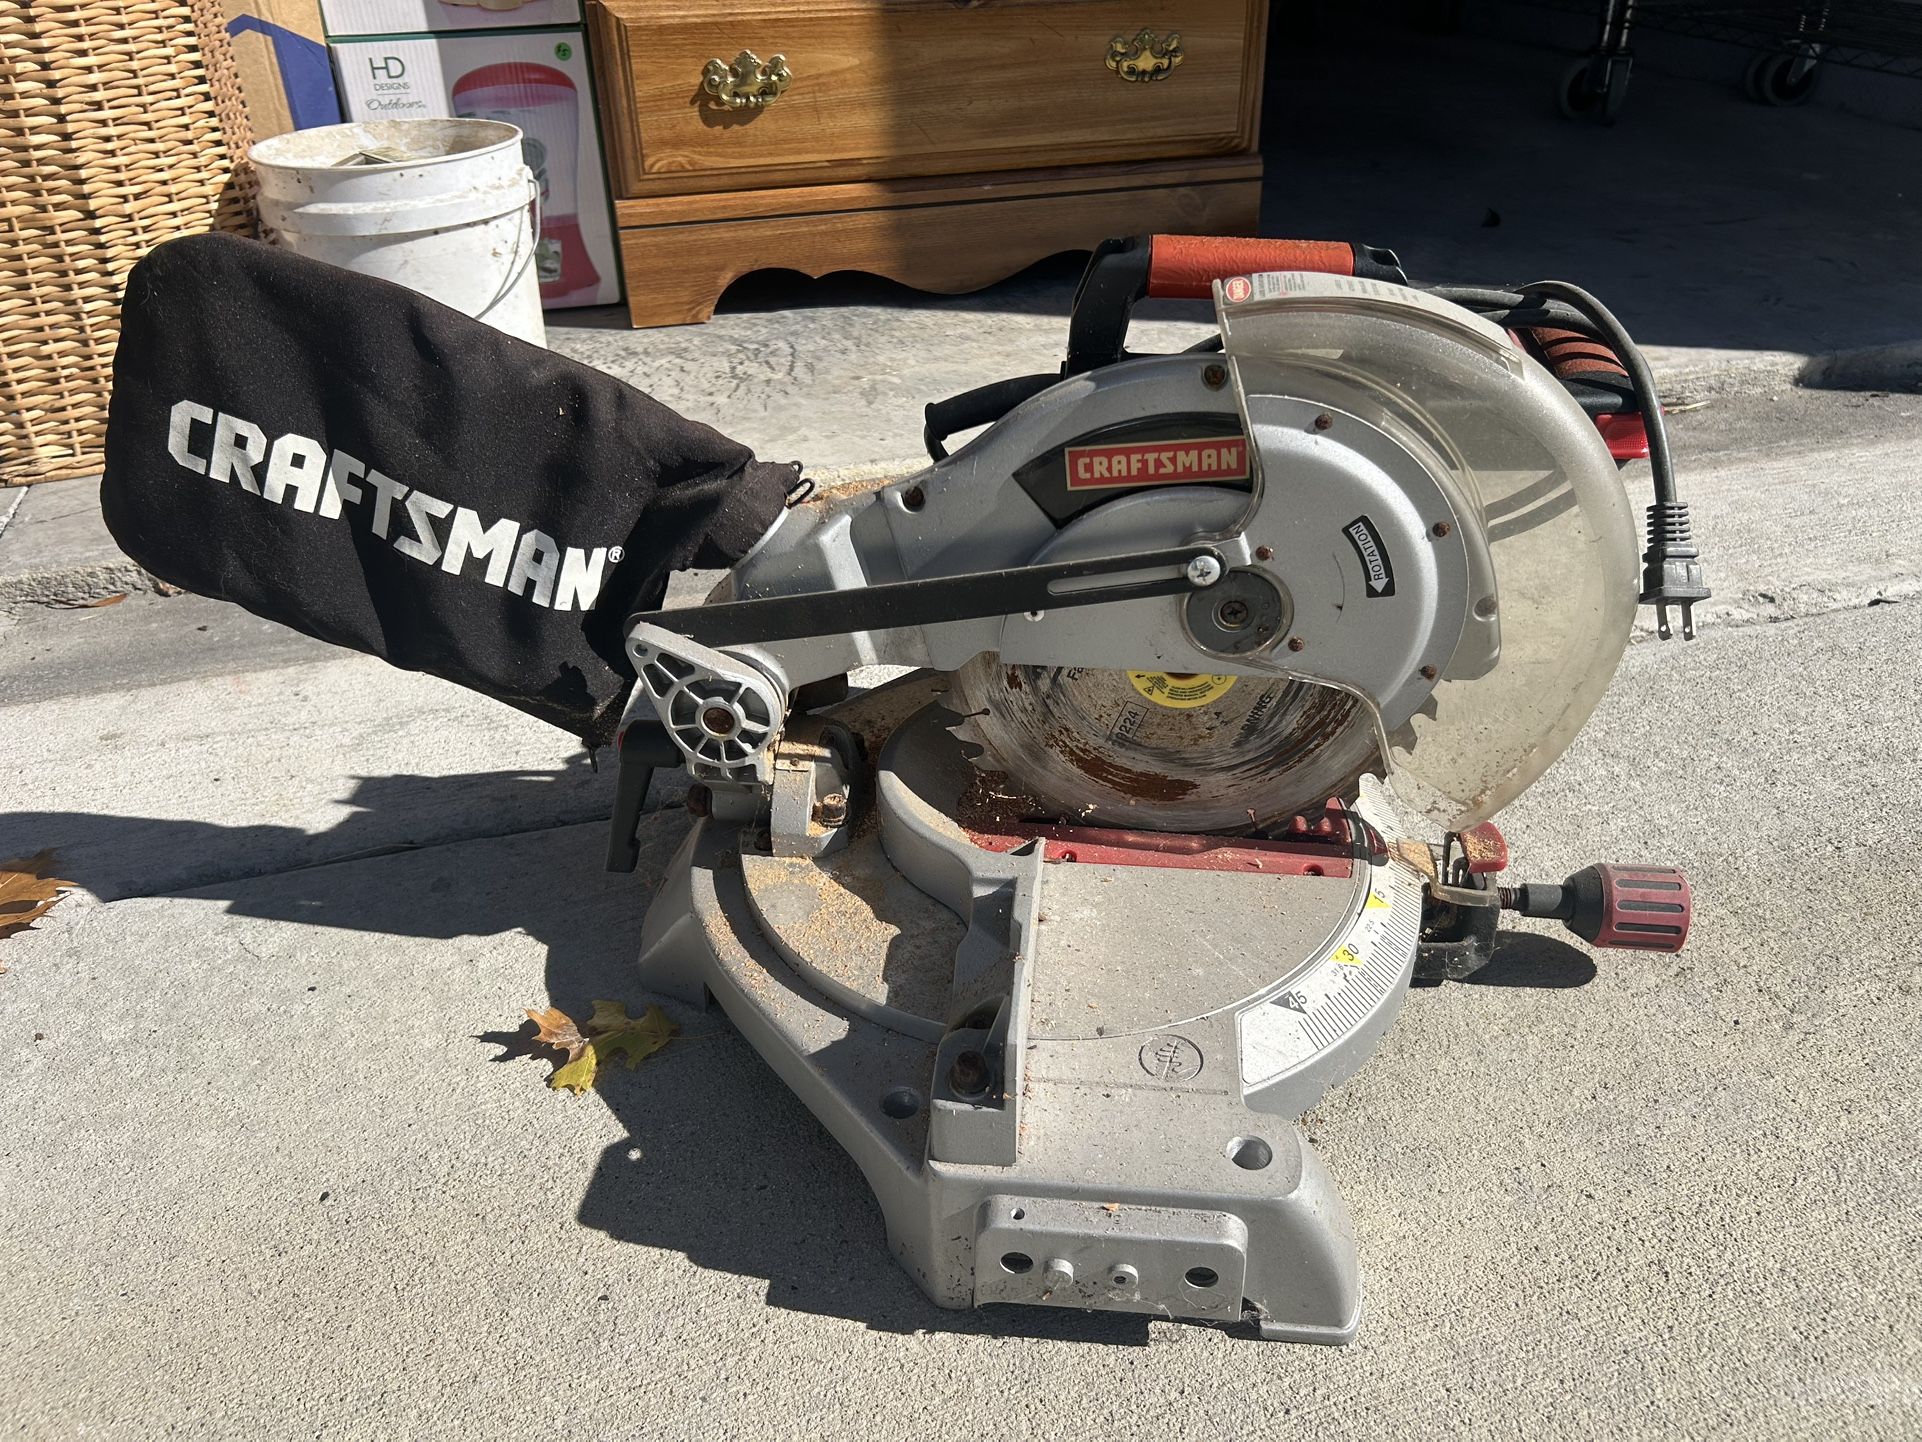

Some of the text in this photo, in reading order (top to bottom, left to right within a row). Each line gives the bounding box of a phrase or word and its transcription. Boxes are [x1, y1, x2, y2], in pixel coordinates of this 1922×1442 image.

[369, 56, 405, 79] HD
[373, 81, 410, 91] DESIGNS
[1077, 447, 1238, 479] CRAFTSMAN
[1352, 525, 1383, 580] ROTATION
[1373, 888, 1386, 903] 15
[1342, 943, 1359, 961] 30
[1288, 991, 1307, 1009] 45
